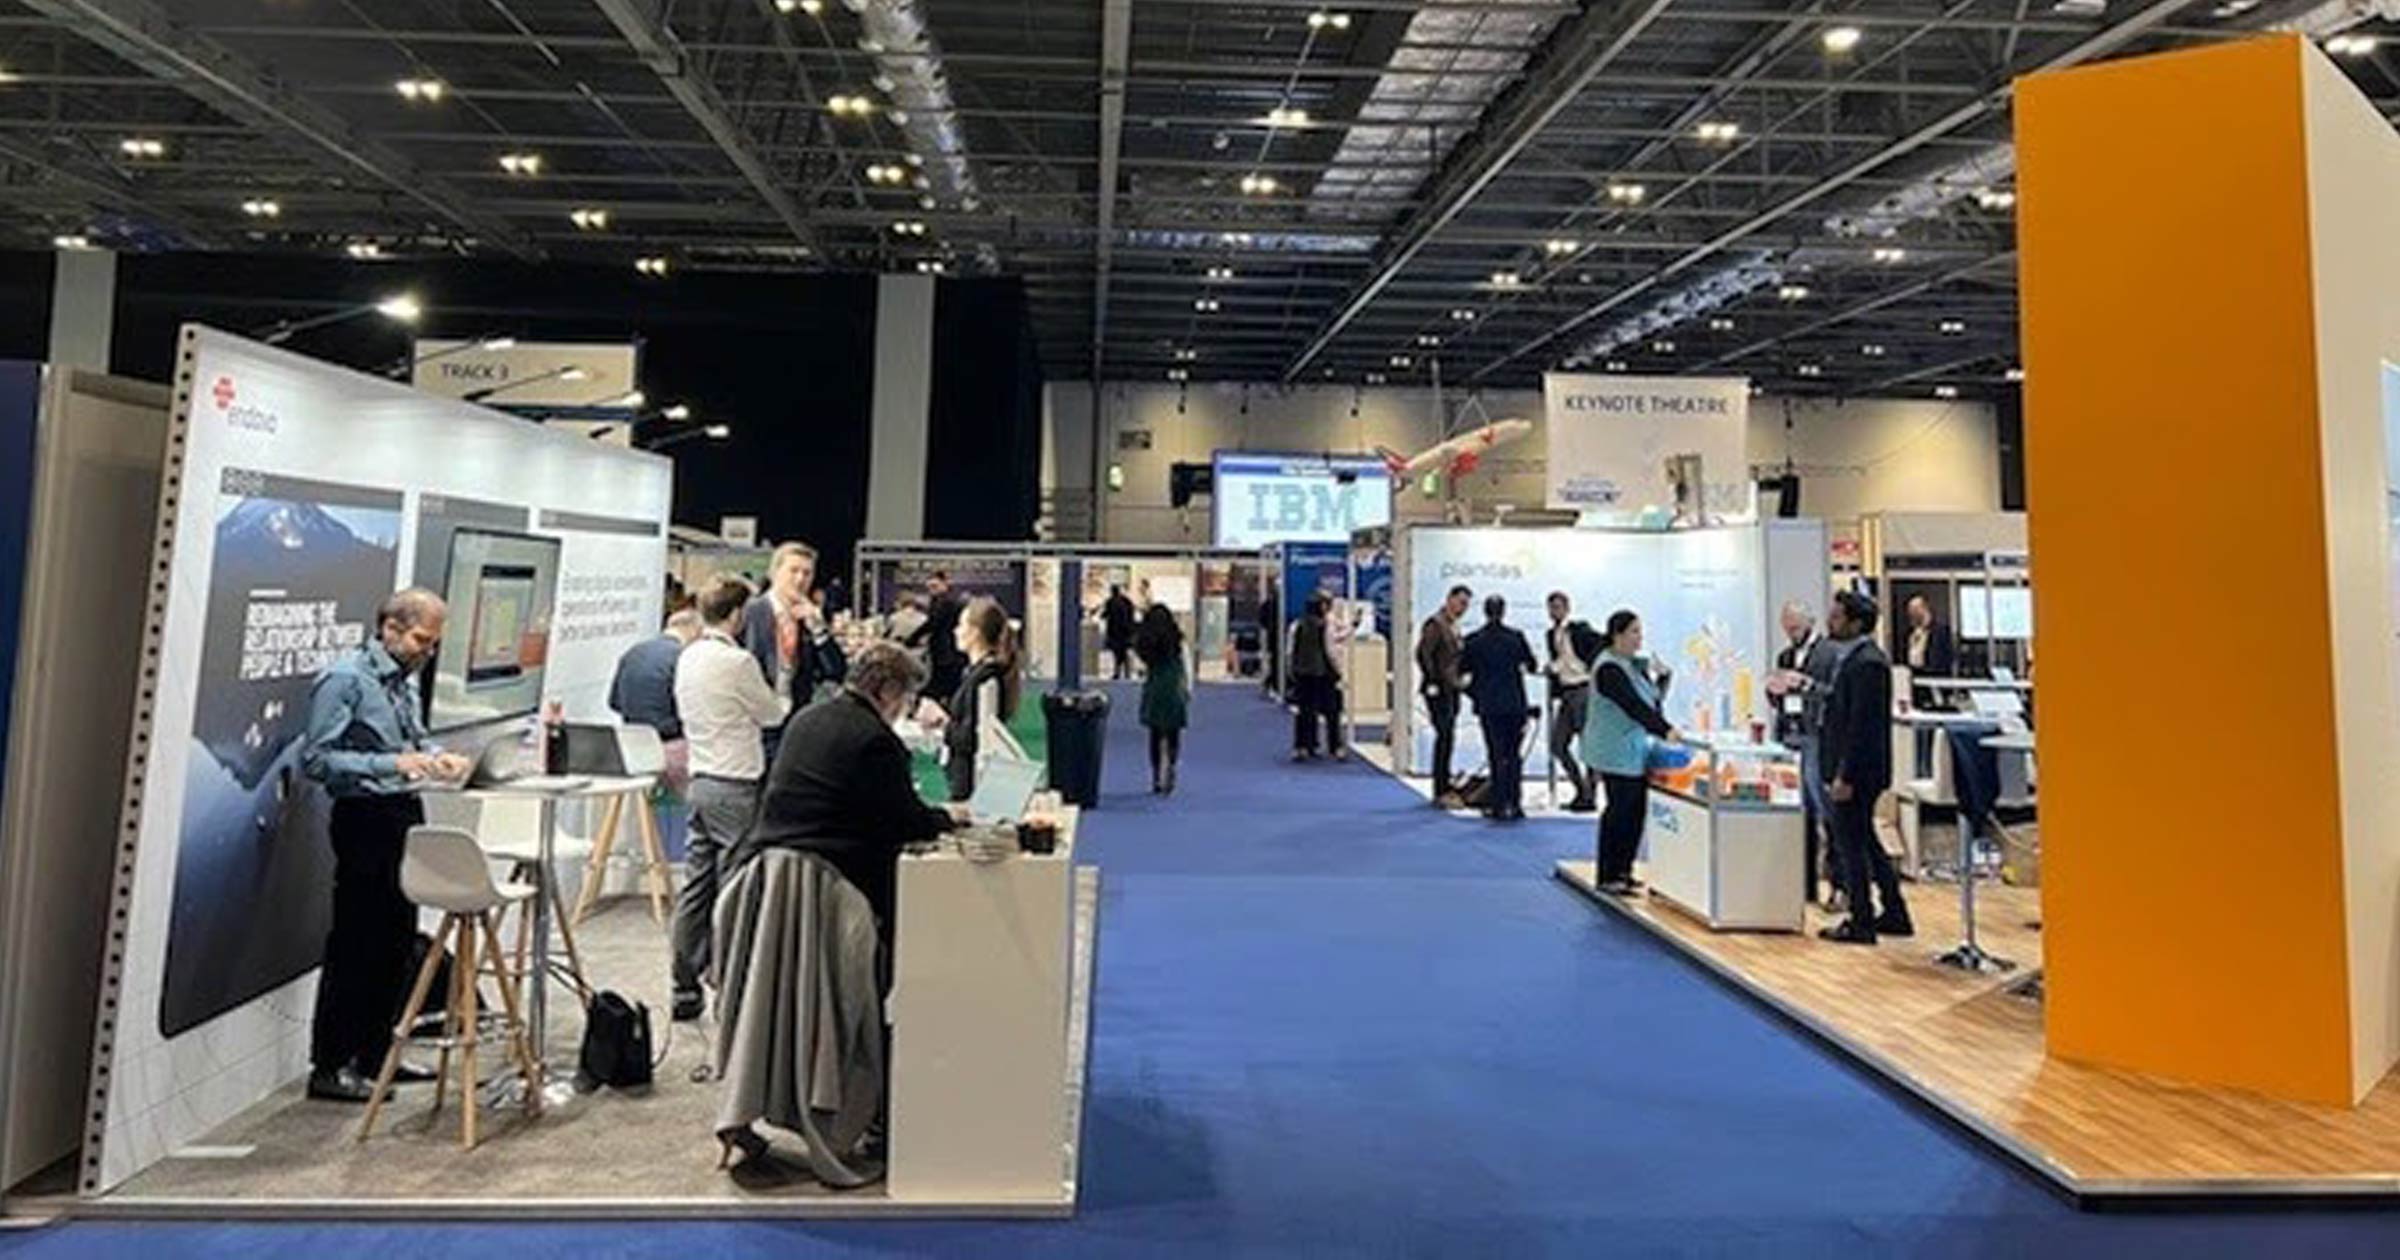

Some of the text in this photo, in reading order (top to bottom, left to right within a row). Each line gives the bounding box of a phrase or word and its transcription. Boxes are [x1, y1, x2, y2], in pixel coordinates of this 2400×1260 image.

[441, 362, 494, 380] TRACK
[1565, 394, 1729, 415] KEYNOTE THEATRE
[1247, 484, 1359, 531] IBM
